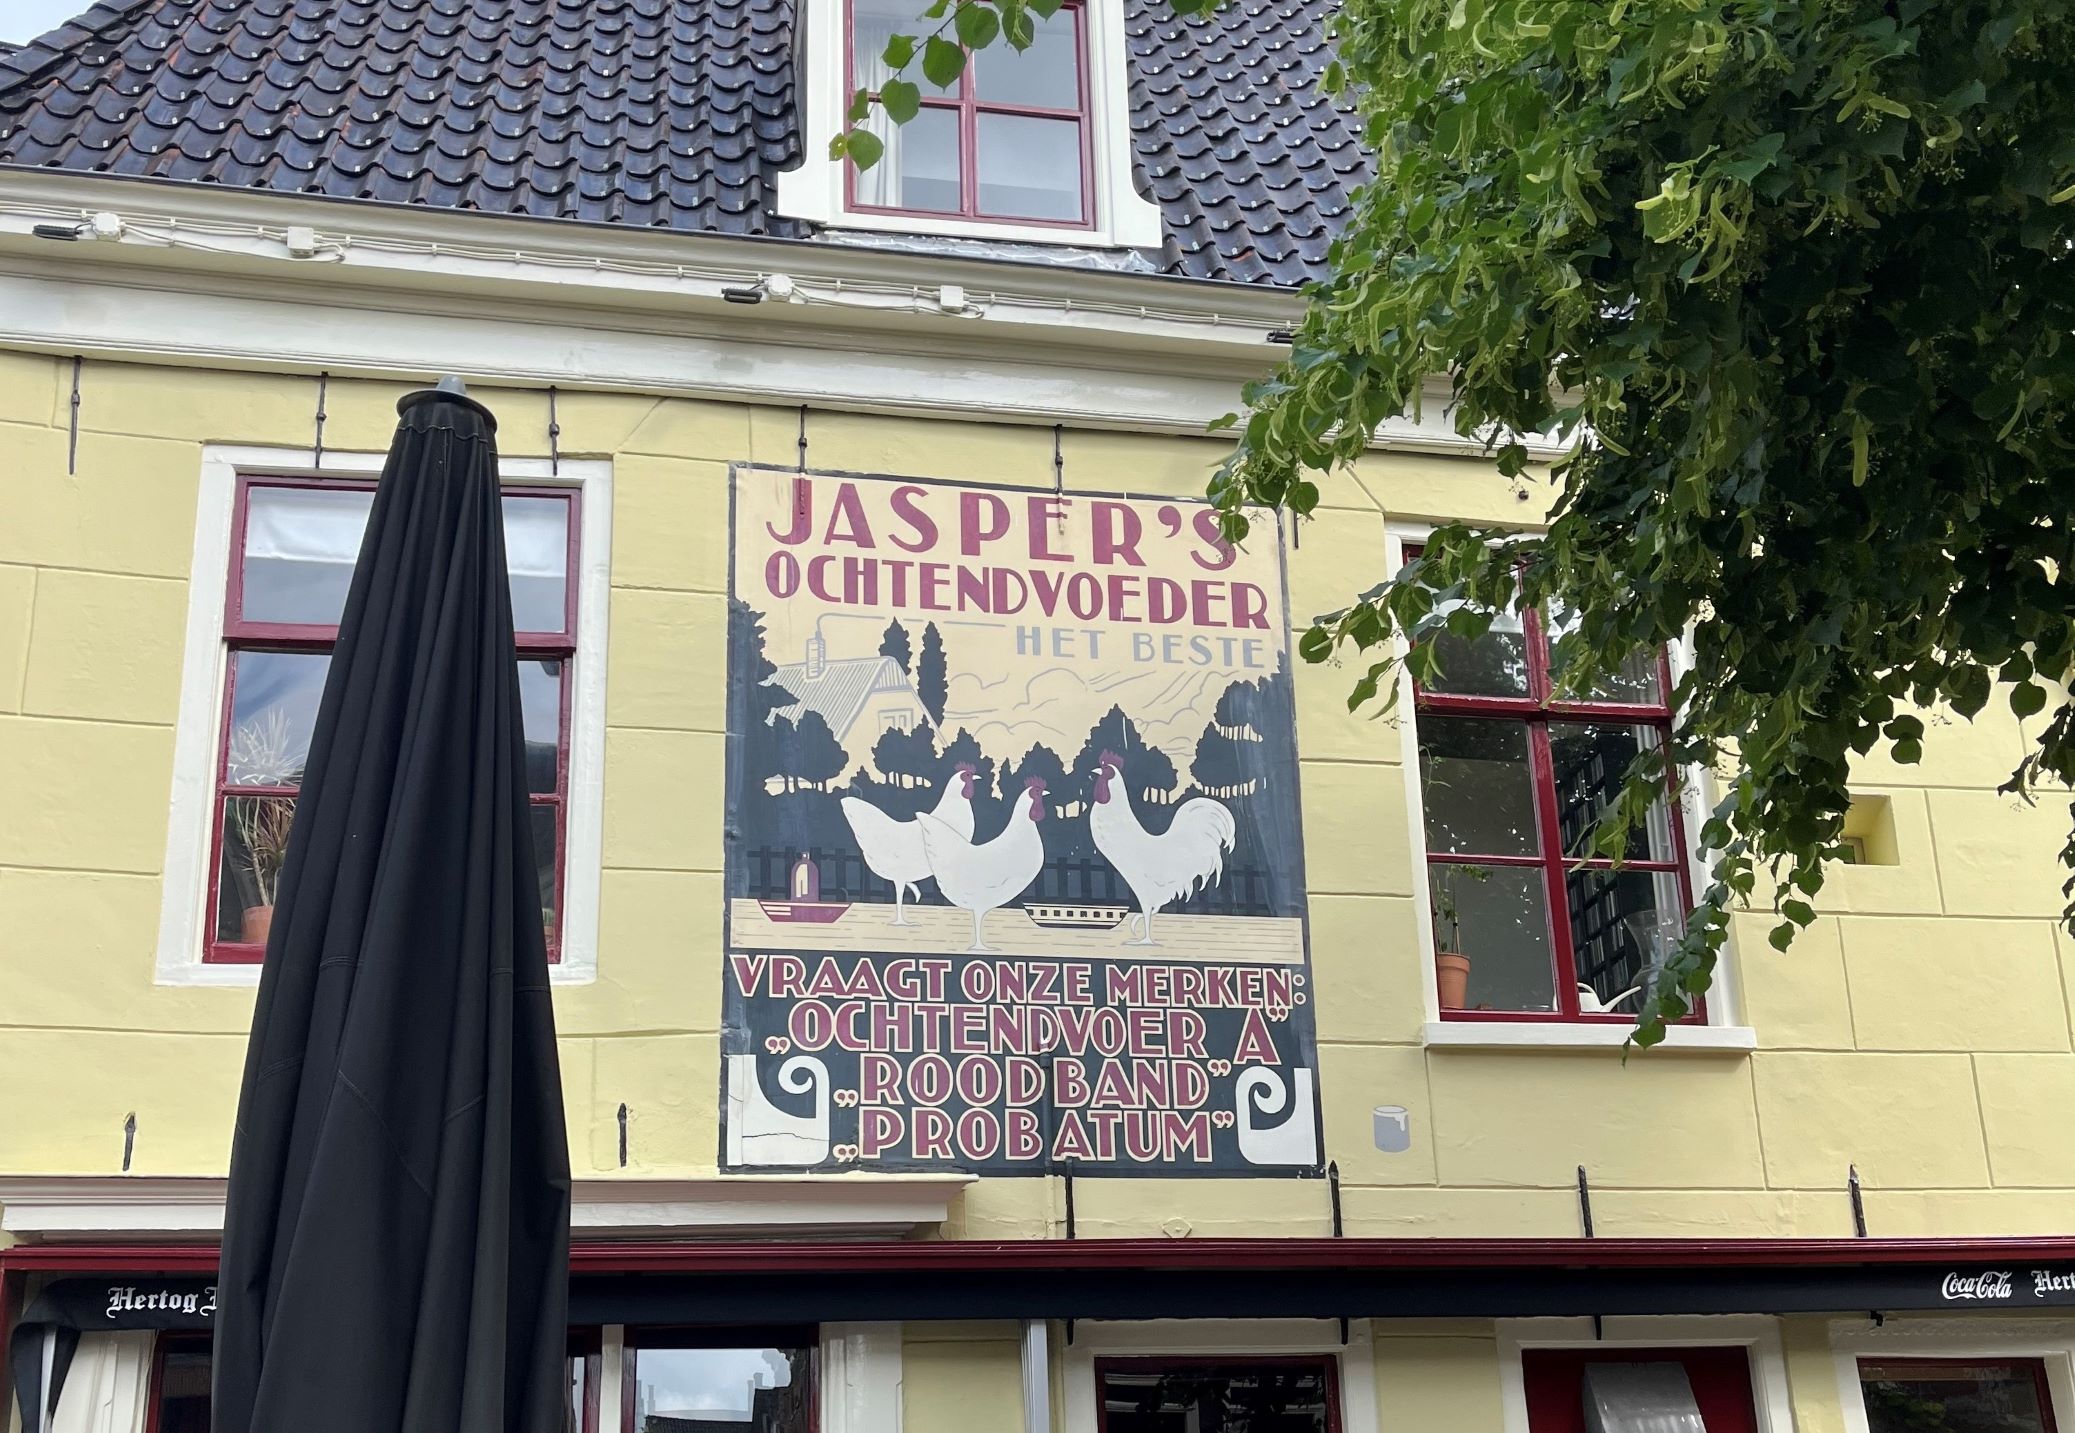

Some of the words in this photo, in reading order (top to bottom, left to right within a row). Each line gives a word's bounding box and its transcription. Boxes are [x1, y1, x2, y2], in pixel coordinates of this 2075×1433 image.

[765, 550, 1271, 629] OCHTENDVOEDER
[1017, 626, 1106, 660] HET
[1133, 632, 1265, 668] BESTE
[729, 954, 952, 999] VRAAGT
[961, 960, 1094, 1004] ONZE
[1106, 964, 1307, 1010] MERKEN:
[106, 1286, 199, 1318] Hertog
[1942, 1271, 2013, 1300] Coca-Cola
